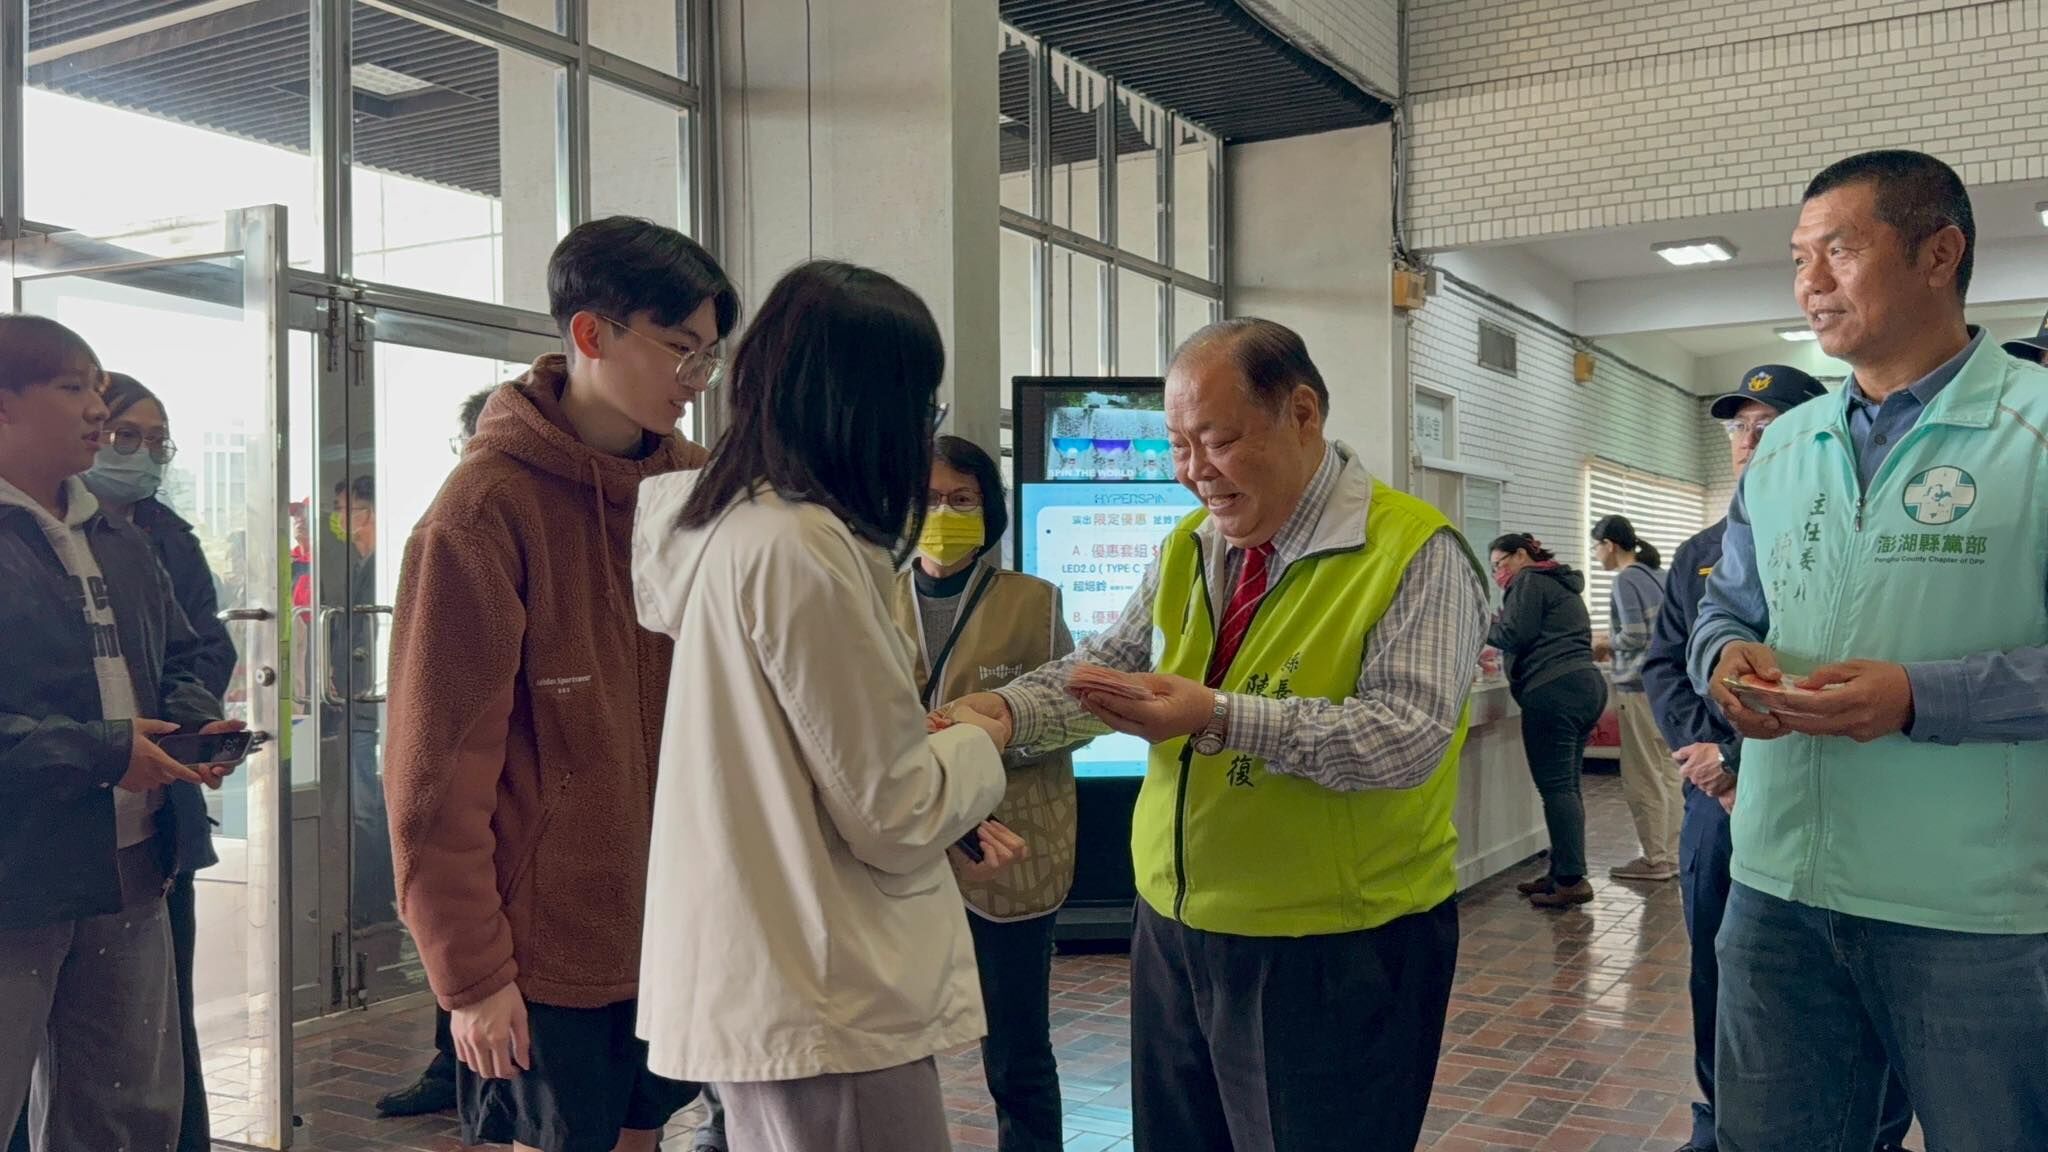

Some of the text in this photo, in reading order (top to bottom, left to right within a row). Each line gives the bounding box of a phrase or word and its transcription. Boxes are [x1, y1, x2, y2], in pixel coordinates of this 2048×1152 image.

[1048, 469, 1134, 477] SPIN THE WORLD
[1876, 533, 1988, 555] 澎湖縣黨部
[1092, 544, 1148, 558] 優惠套組
[1874, 556, 1900, 564] Penghu
[1928, 556, 1957, 564] Chapter
[1969, 557, 1985, 565] DPP
[1062, 564, 1096, 573] LED2.0
[1107, 564, 1129, 573] TYPE
